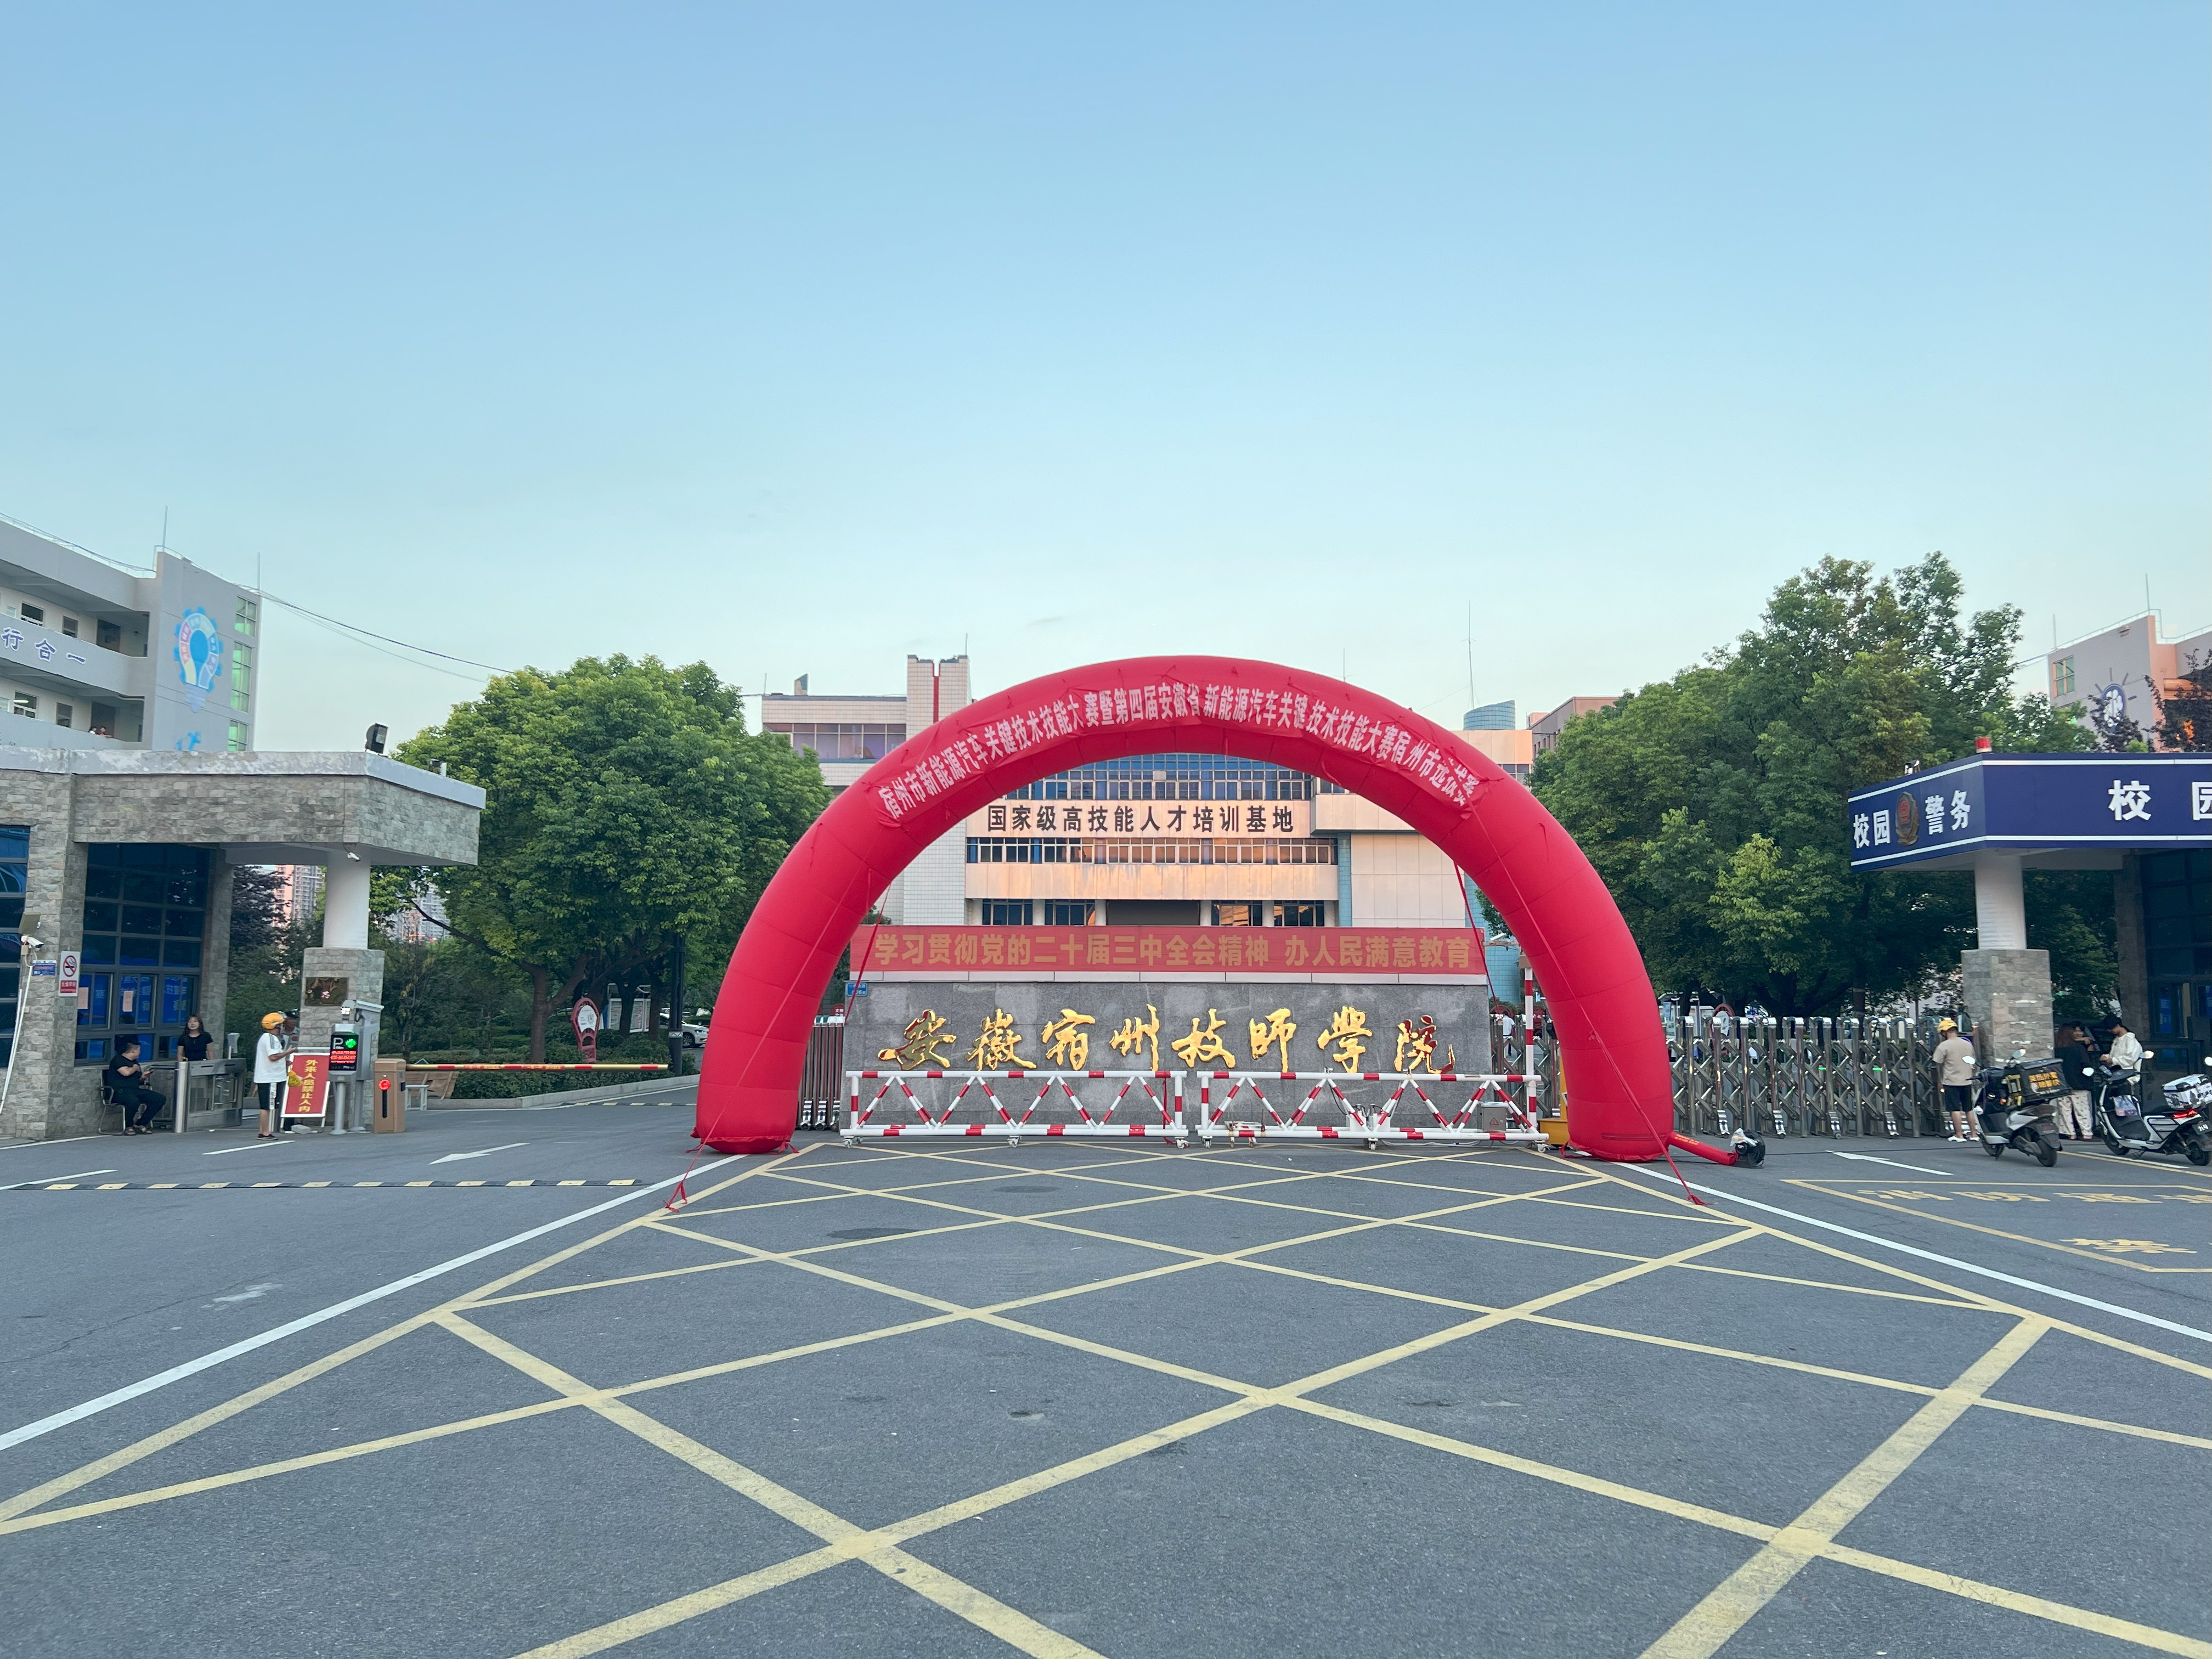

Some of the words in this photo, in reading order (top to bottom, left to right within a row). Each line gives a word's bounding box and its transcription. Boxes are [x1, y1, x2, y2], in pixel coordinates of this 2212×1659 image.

[1, 627, 86, 664] 行合一
[988, 805, 1293, 832] 国家级高技能人才培训基地
[1853, 809, 1891, 848] 校园
[1925, 790, 1971, 835] 警务
[875, 934, 1268, 967] 学习贯彻党的二十届三中全会精神
[1284, 935, 1471, 968] 办人民满意教育
